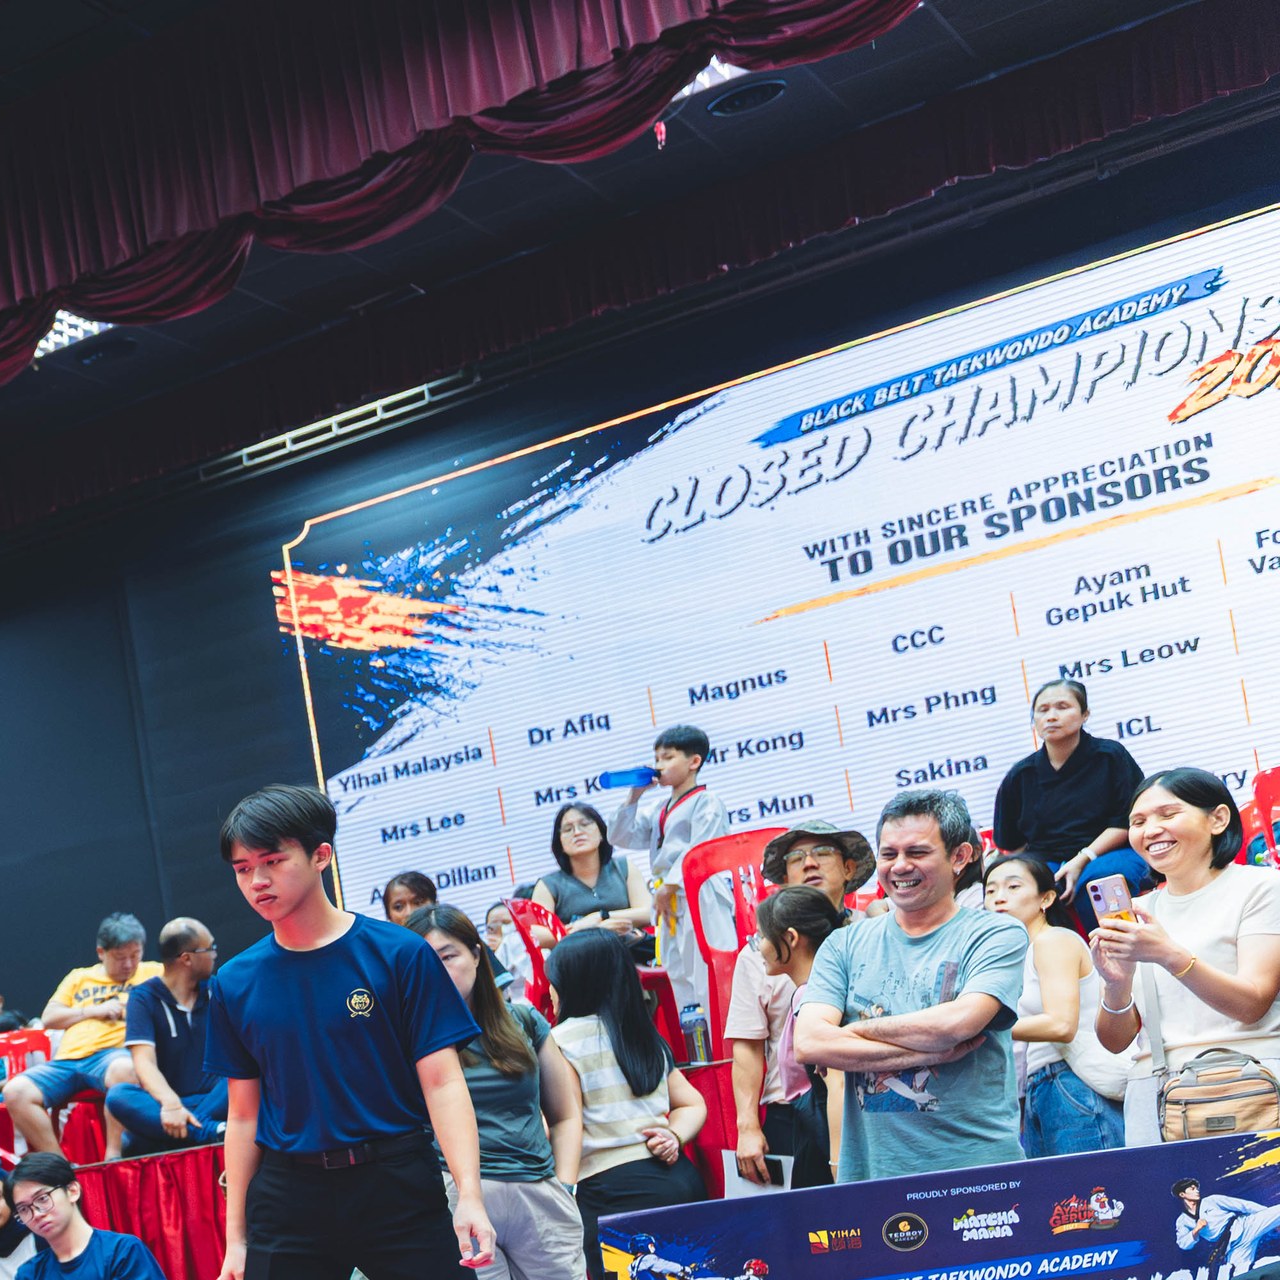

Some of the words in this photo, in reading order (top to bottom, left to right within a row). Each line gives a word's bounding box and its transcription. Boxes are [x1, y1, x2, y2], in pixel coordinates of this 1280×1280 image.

[799, 391, 867, 432] BLACK
[873, 372, 929, 409] BELT
[932, 324, 1072, 388] TAEKWONDO
[1075, 283, 1189, 337] ACADEMY
[639, 424, 873, 543] CLOSED
[803, 528, 872, 561] WITH
[881, 494, 996, 541] SINCERE
[1006, 431, 1215, 503] APPRECIATION
[820, 548, 874, 583] TO
[888, 523, 970, 566] OUR
[985, 456, 1212, 540] SPONSORS
[1073, 561, 1151, 595] Ayam
[1045, 590, 1134, 628] Gepuk
[1140, 576, 1193, 604] Hut
[891, 625, 946, 654] CCC
[1059, 655, 1114, 682] Mrs
[1121, 635, 1201, 669] Leow
[687, 666, 789, 706] Magnus
[867, 701, 918, 729] Mrs
[924, 684, 998, 715] Phng
[527, 723, 556, 747] Dr
[562, 711, 612, 740] Afiq
[736, 731, 804, 759] Kong
[1116, 715, 1162, 741] ICL
[337, 764, 389, 794] Yihai
[392, 743, 484, 780] Malaysia
[895, 753, 989, 788] Sakina
[534, 784, 578, 807] Mrs
[728, 807, 752, 825] rs
[758, 793, 815, 818] Mun
[380, 822, 421, 844] Mrs
[426, 811, 466, 834] Lee
[436, 863, 497, 890] Dillan
[906, 1188, 949, 1201] PROUDLY
[950, 1182, 1007, 1197] SPONSORED
[1009, 1180, 1022, 1190] BY
[829, 1228, 861, 1238] YIHAI
[1037, 1249, 1119, 1275] ACADEMY
